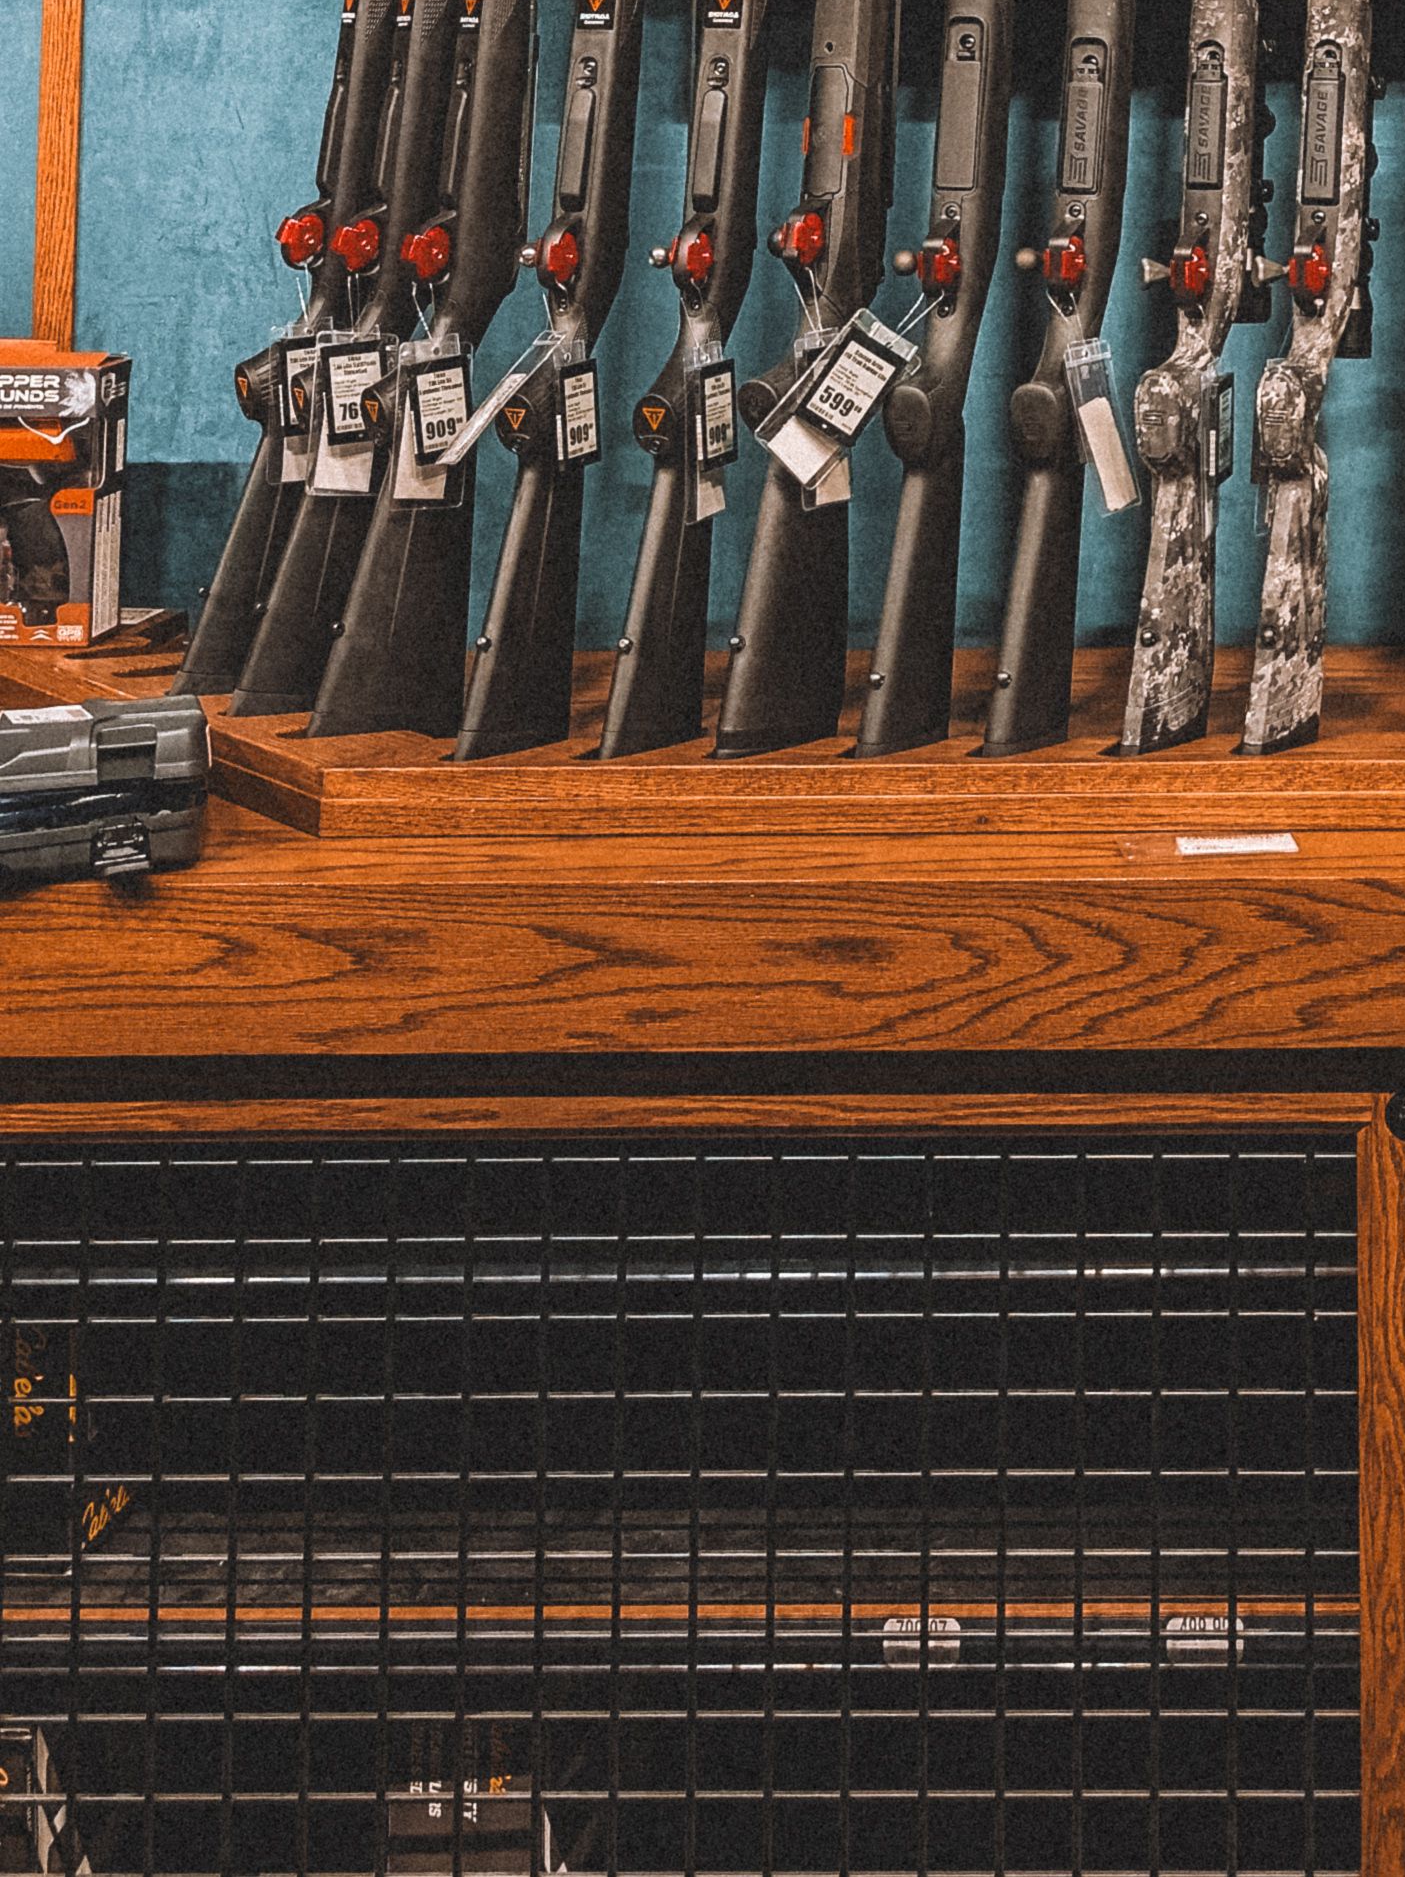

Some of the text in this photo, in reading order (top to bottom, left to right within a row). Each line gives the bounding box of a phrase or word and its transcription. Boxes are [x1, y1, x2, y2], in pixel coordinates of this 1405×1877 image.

[1202, 84, 1212, 149] SAVAGE
[1314, 89, 1329, 154] SAVAGE
[0, 389, 60, 403] UNDS
[819, 384, 855, 417] 599
[339, 402, 360, 422] 76
[425, 417, 457, 441] 909
[569, 423, 590, 446] 909
[709, 423, 727, 446] 909
